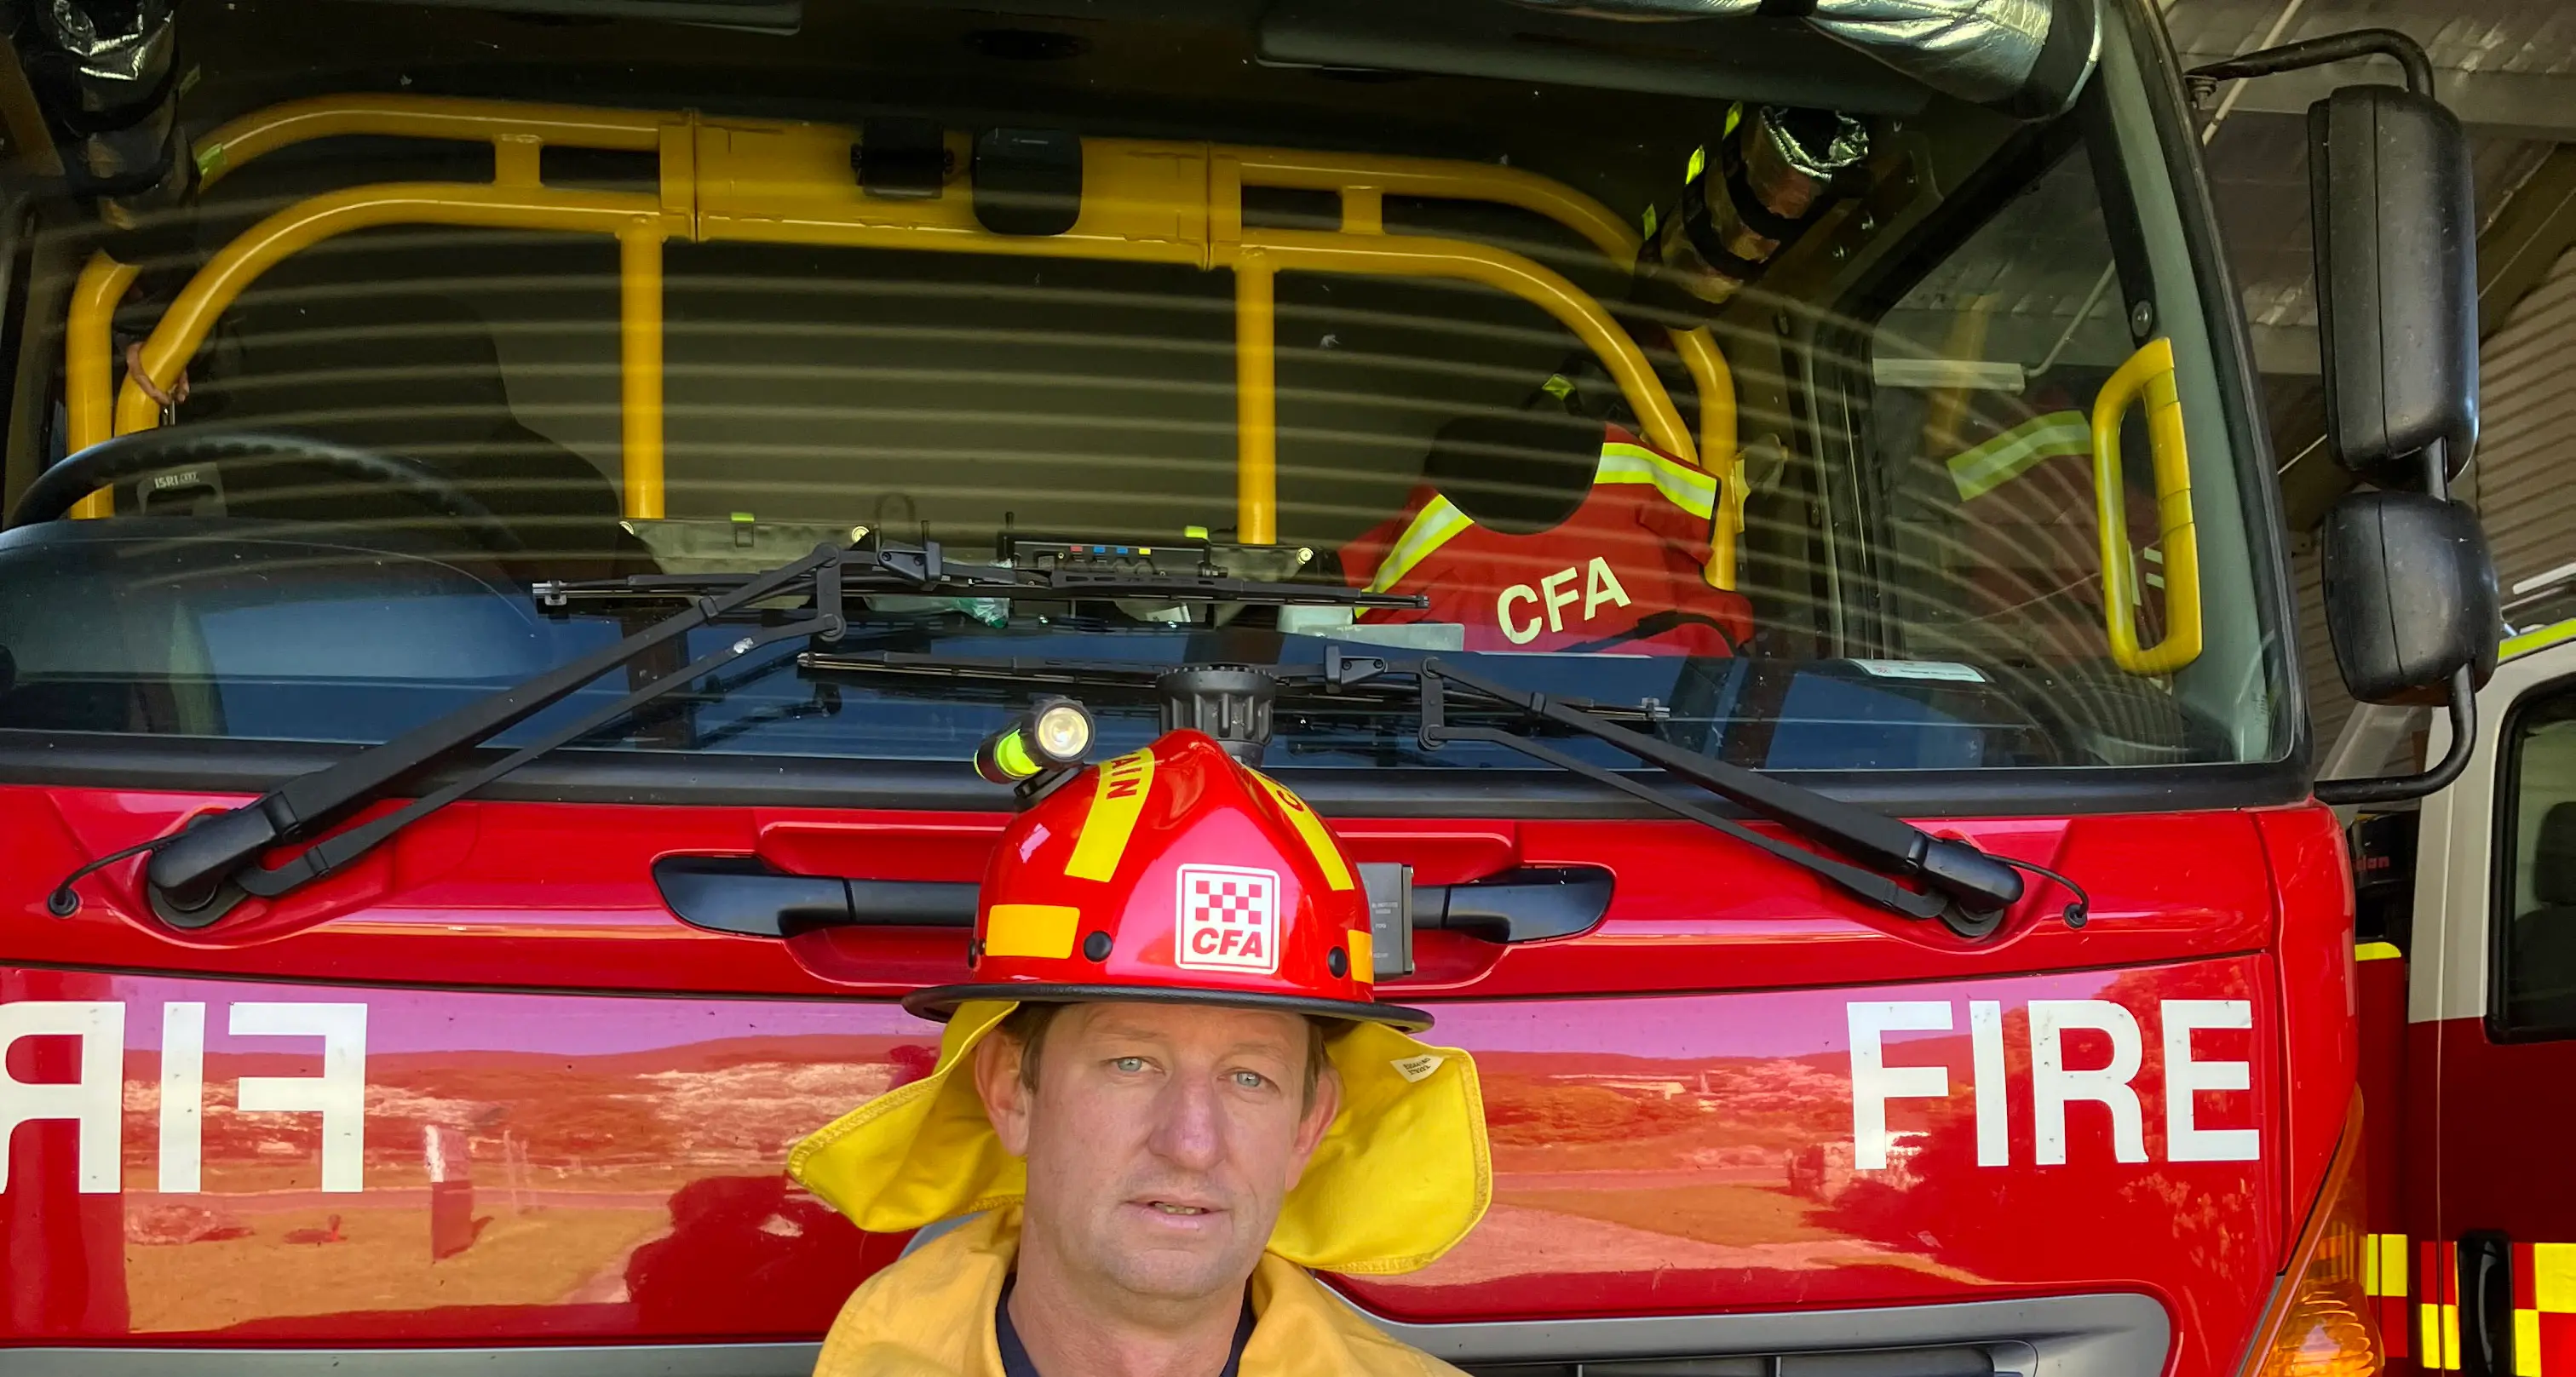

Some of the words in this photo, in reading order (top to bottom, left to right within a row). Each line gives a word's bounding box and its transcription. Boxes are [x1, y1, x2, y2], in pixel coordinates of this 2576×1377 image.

[1497, 556, 1632, 645] CFA
[1106, 751, 1142, 800] AIN
[1192, 927, 1262, 958] CFA
[1846, 1000, 2261, 1170] FIRE
